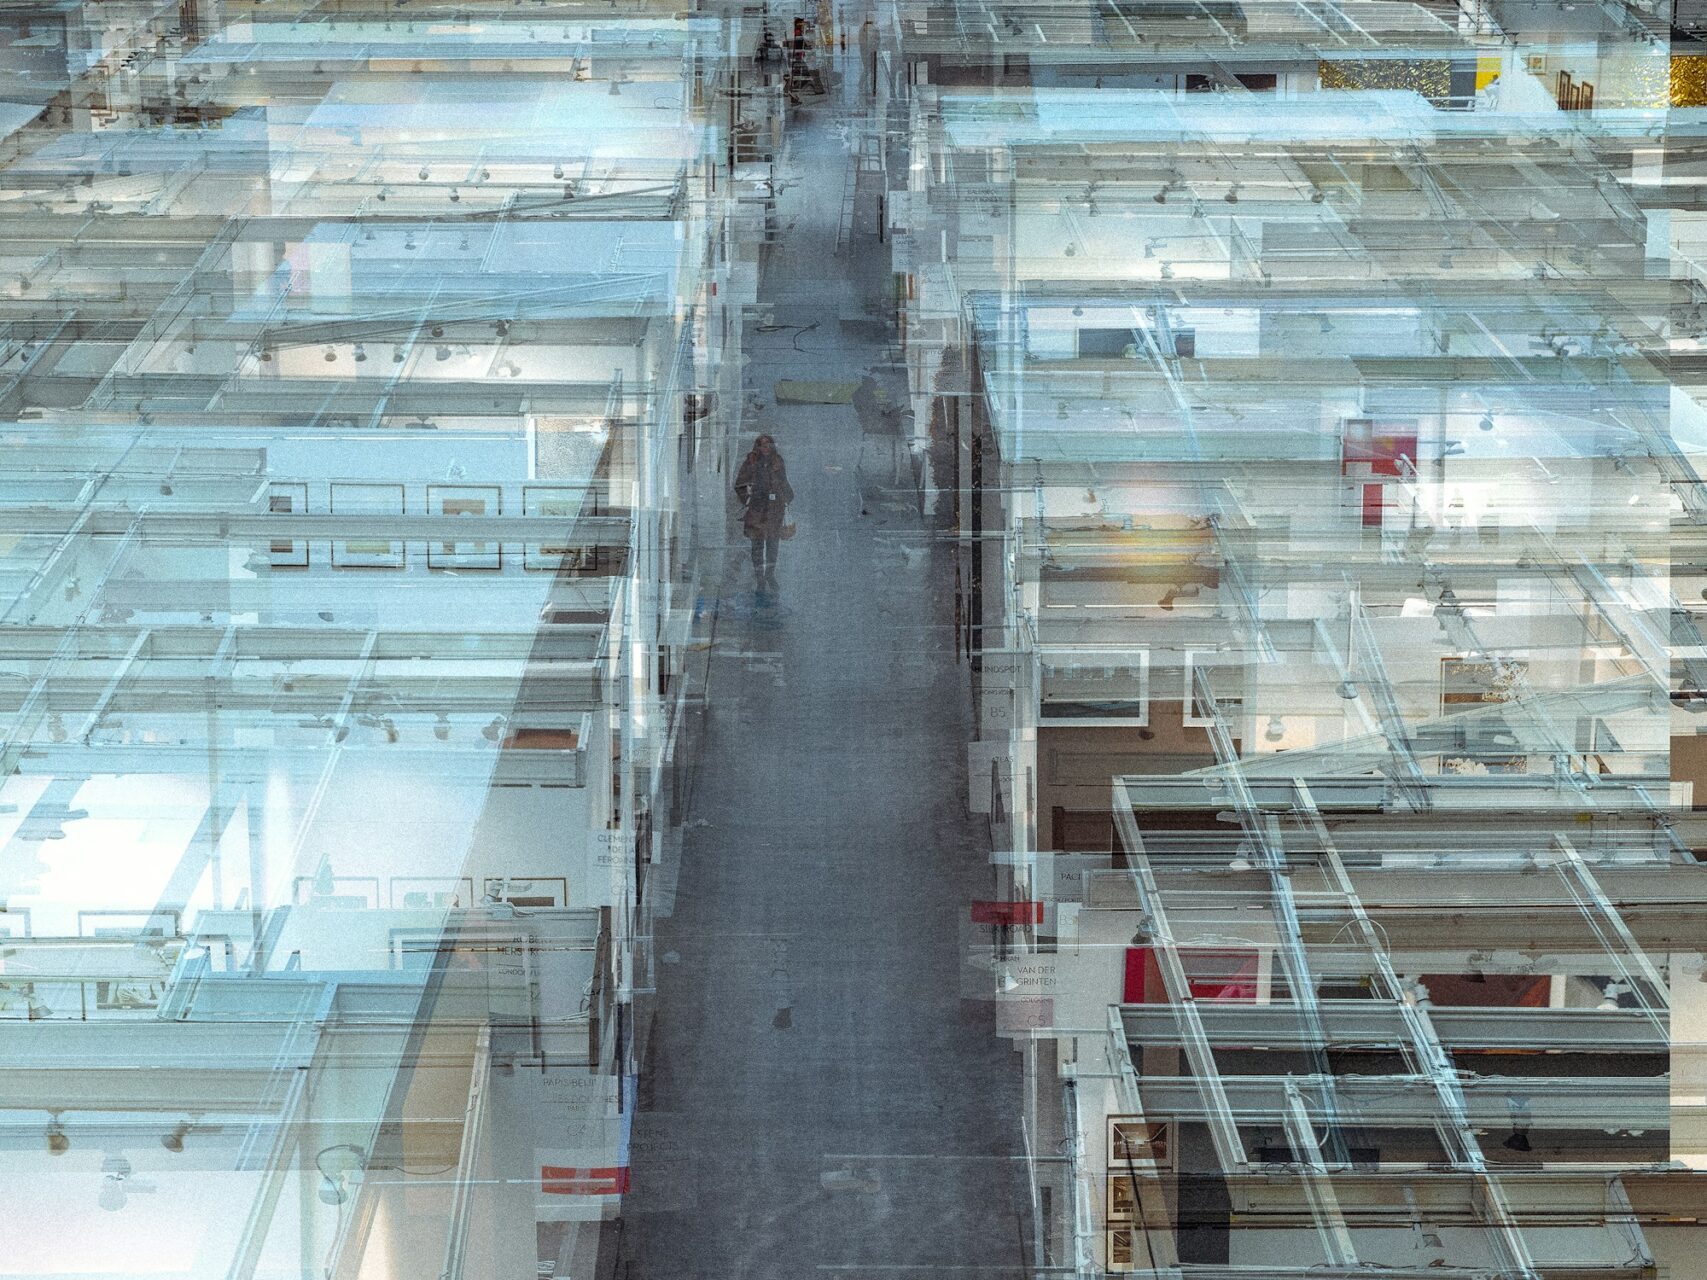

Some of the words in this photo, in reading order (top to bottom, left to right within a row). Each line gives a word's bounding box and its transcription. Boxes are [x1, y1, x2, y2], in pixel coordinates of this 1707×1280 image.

[990, 706, 1006, 718] B5
[1018, 966, 1036, 974] VAN
[1037, 966, 1055, 974] DER
[1016, 977, 1056, 986] GRINTEN
[1027, 1015, 1046, 1027] C5
